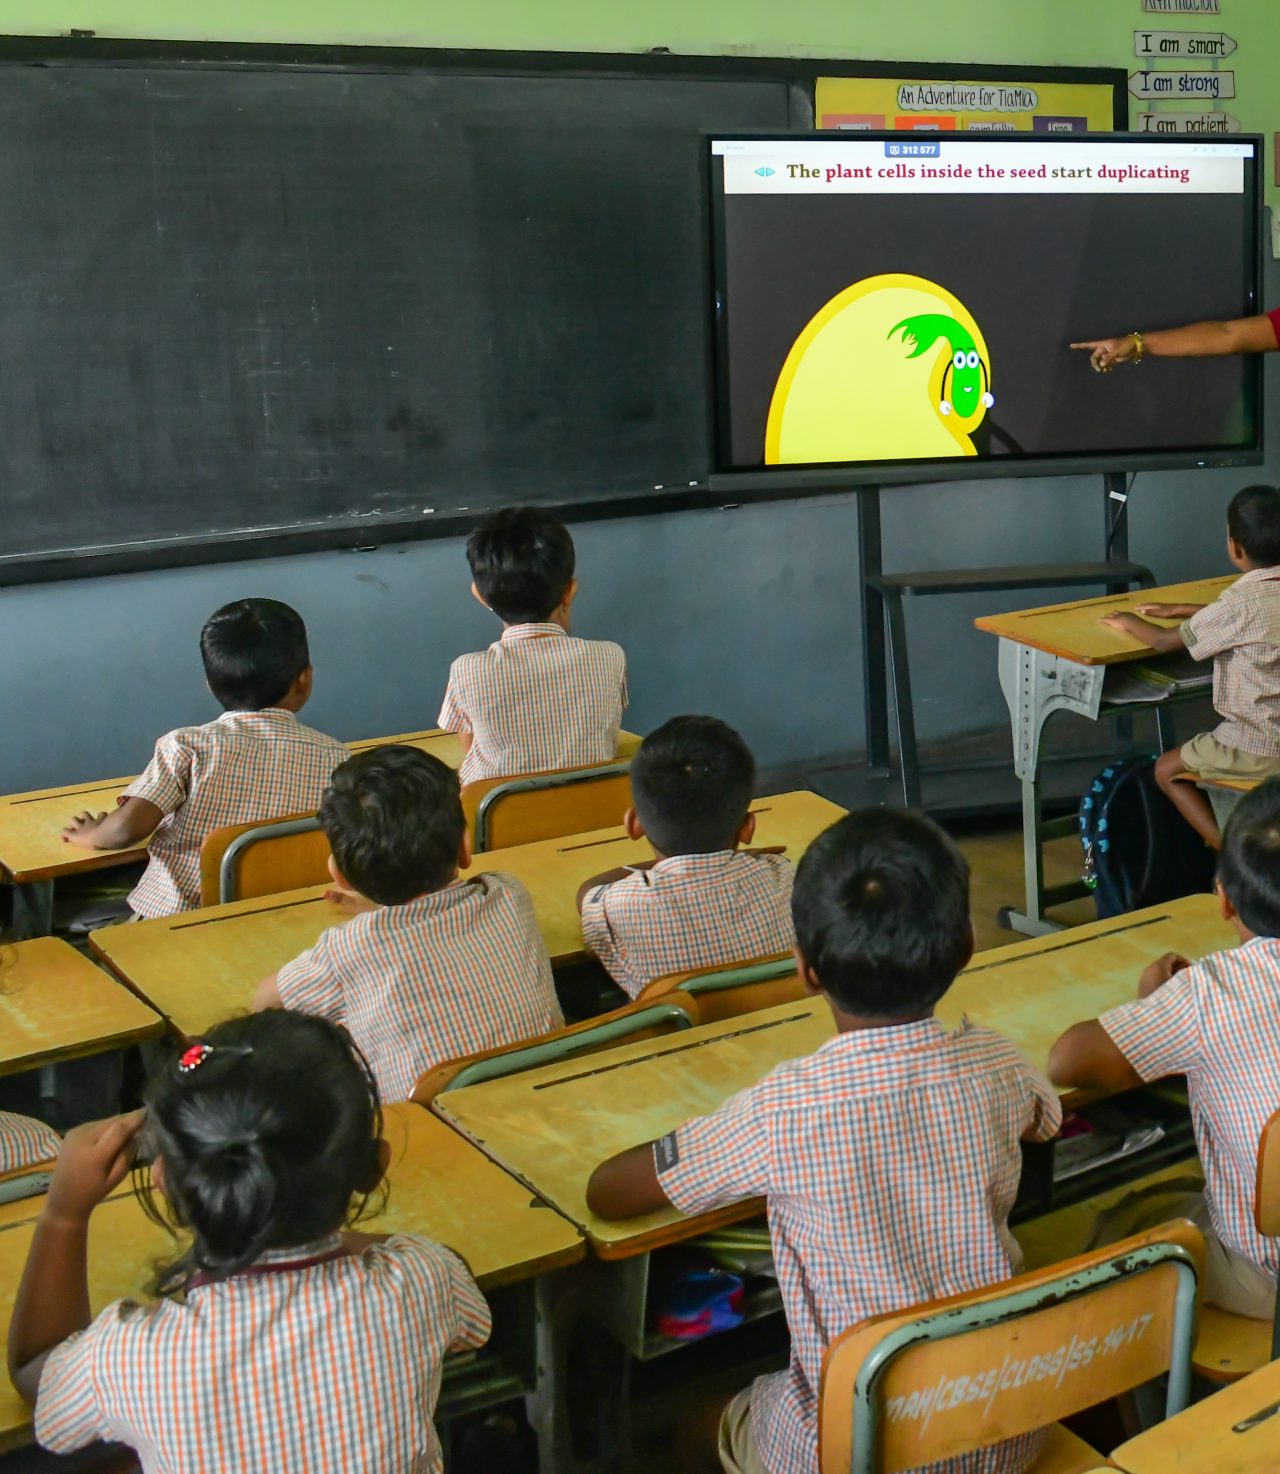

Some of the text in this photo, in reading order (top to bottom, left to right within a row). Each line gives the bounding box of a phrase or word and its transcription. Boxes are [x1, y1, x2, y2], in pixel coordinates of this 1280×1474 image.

[1141, 34, 1225, 55] I am smart
[1140, 71, 1219, 98] I am strong
[900, 86, 914, 104] An
[917, 85, 976, 105] Adventure
[1143, 114, 1229, 133] I am patient
[902, 145, 936, 154] 312 577
[787, 164, 1190, 183] The plant cells inside the seed start duplicating
